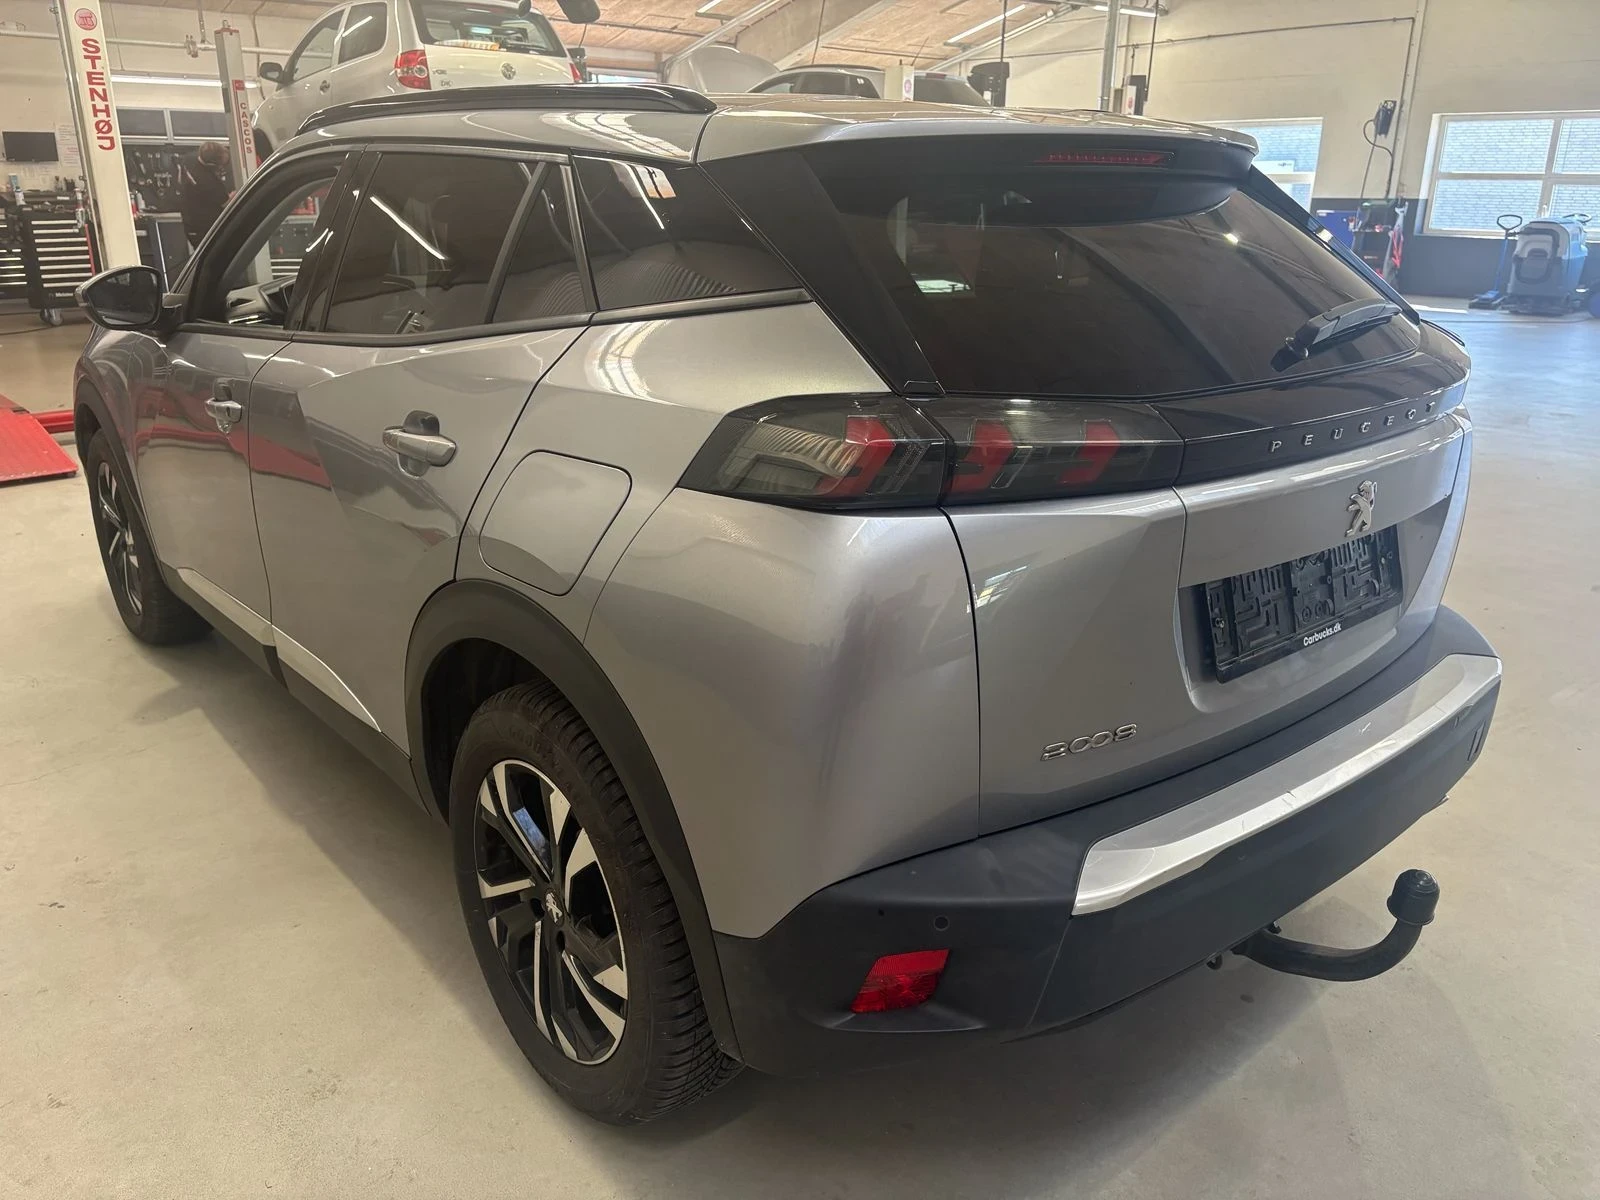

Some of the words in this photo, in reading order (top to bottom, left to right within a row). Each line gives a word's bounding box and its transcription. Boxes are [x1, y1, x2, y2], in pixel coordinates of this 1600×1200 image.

[81, 38, 116, 151] STENHØJ
[240, 102, 252, 154] CASCOS
[1270, 401, 1436, 452] PEUGEOT
[1303, 622, 1342, 646] Carbucks.dk
[1041, 723, 1137, 760] 2008
